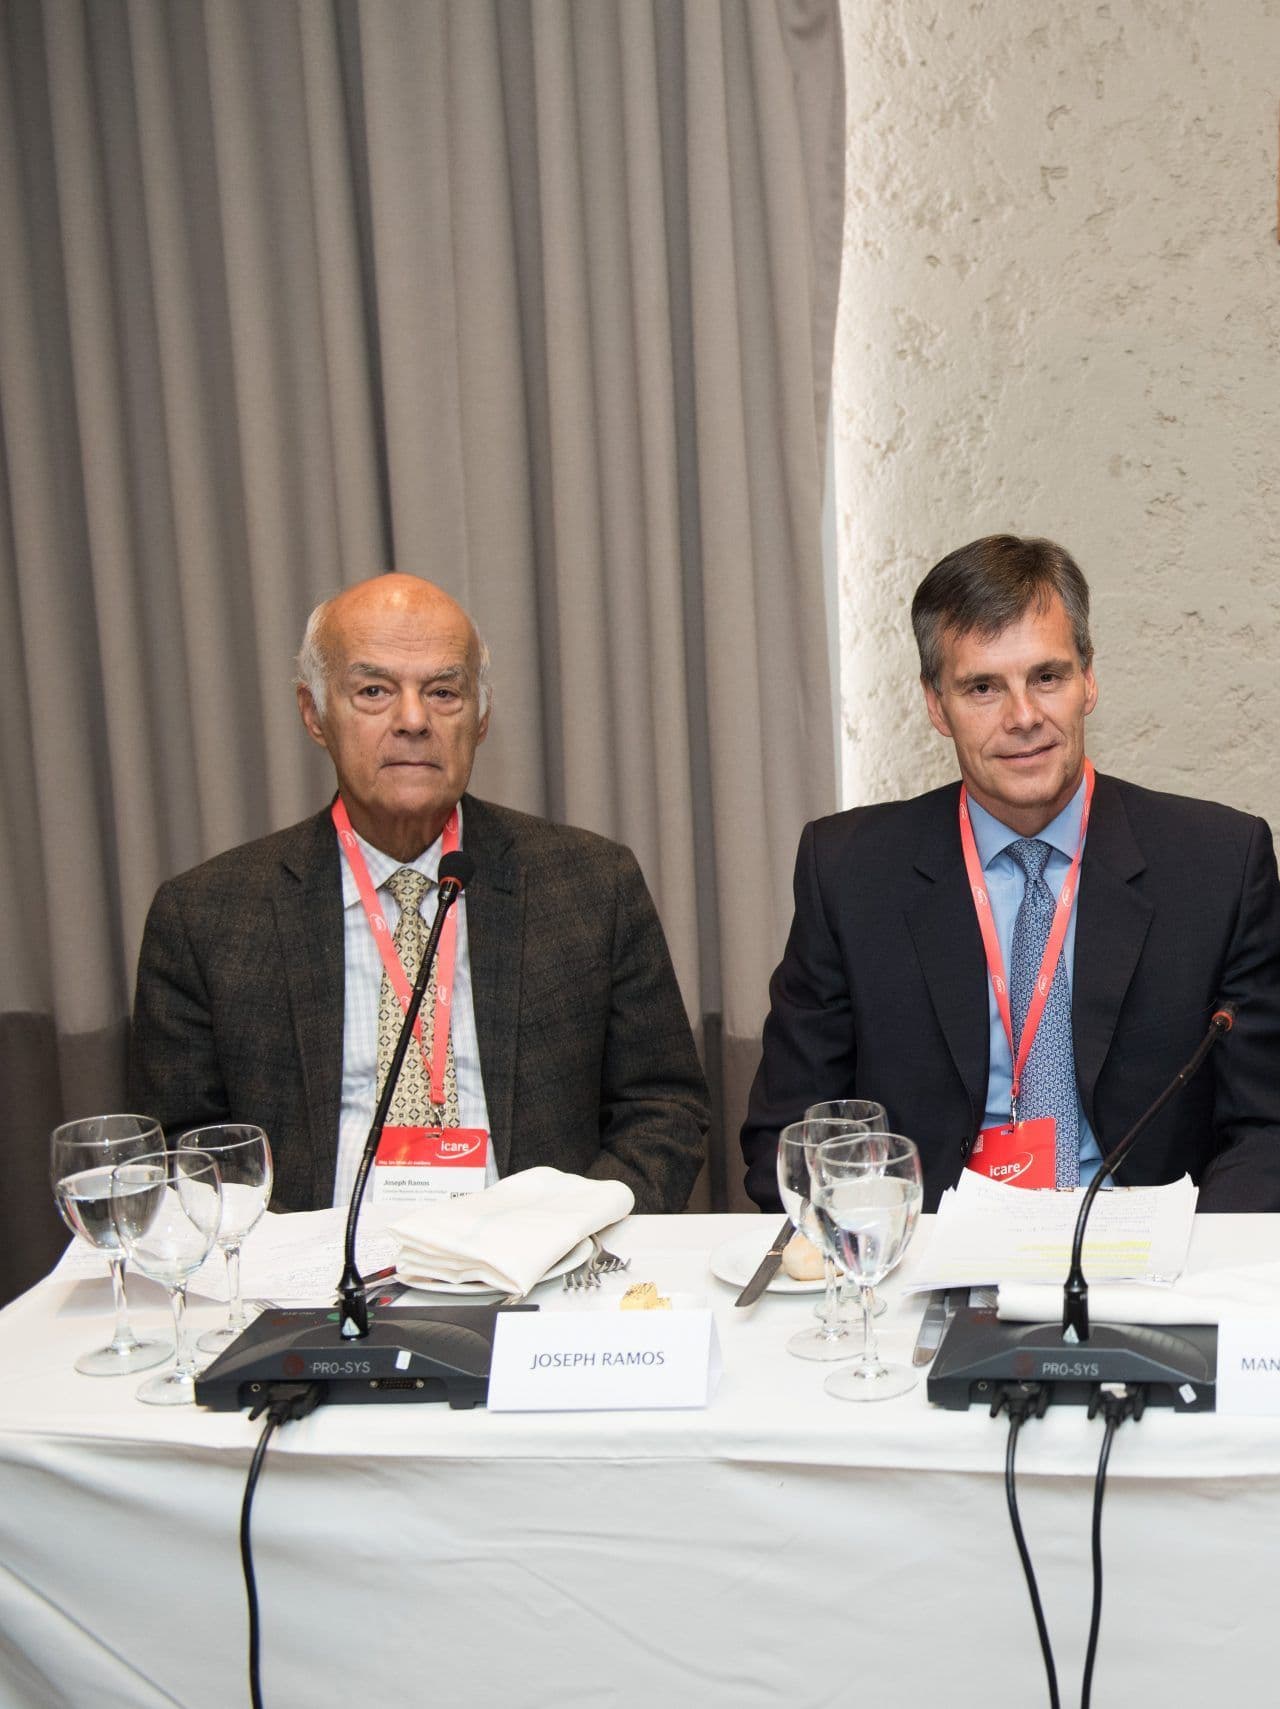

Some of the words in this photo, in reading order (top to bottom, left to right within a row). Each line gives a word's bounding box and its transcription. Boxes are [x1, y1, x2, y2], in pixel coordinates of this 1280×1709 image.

[441, 1141, 469, 1152] icare
[989, 1163, 1021, 1178] icare
[312, 1361, 371, 1375] PRO-SYS
[529, 1352, 596, 1370] JOSEPH
[601, 1351, 665, 1367] RAMOS
[1041, 1361, 1100, 1377] PRO-SYS
